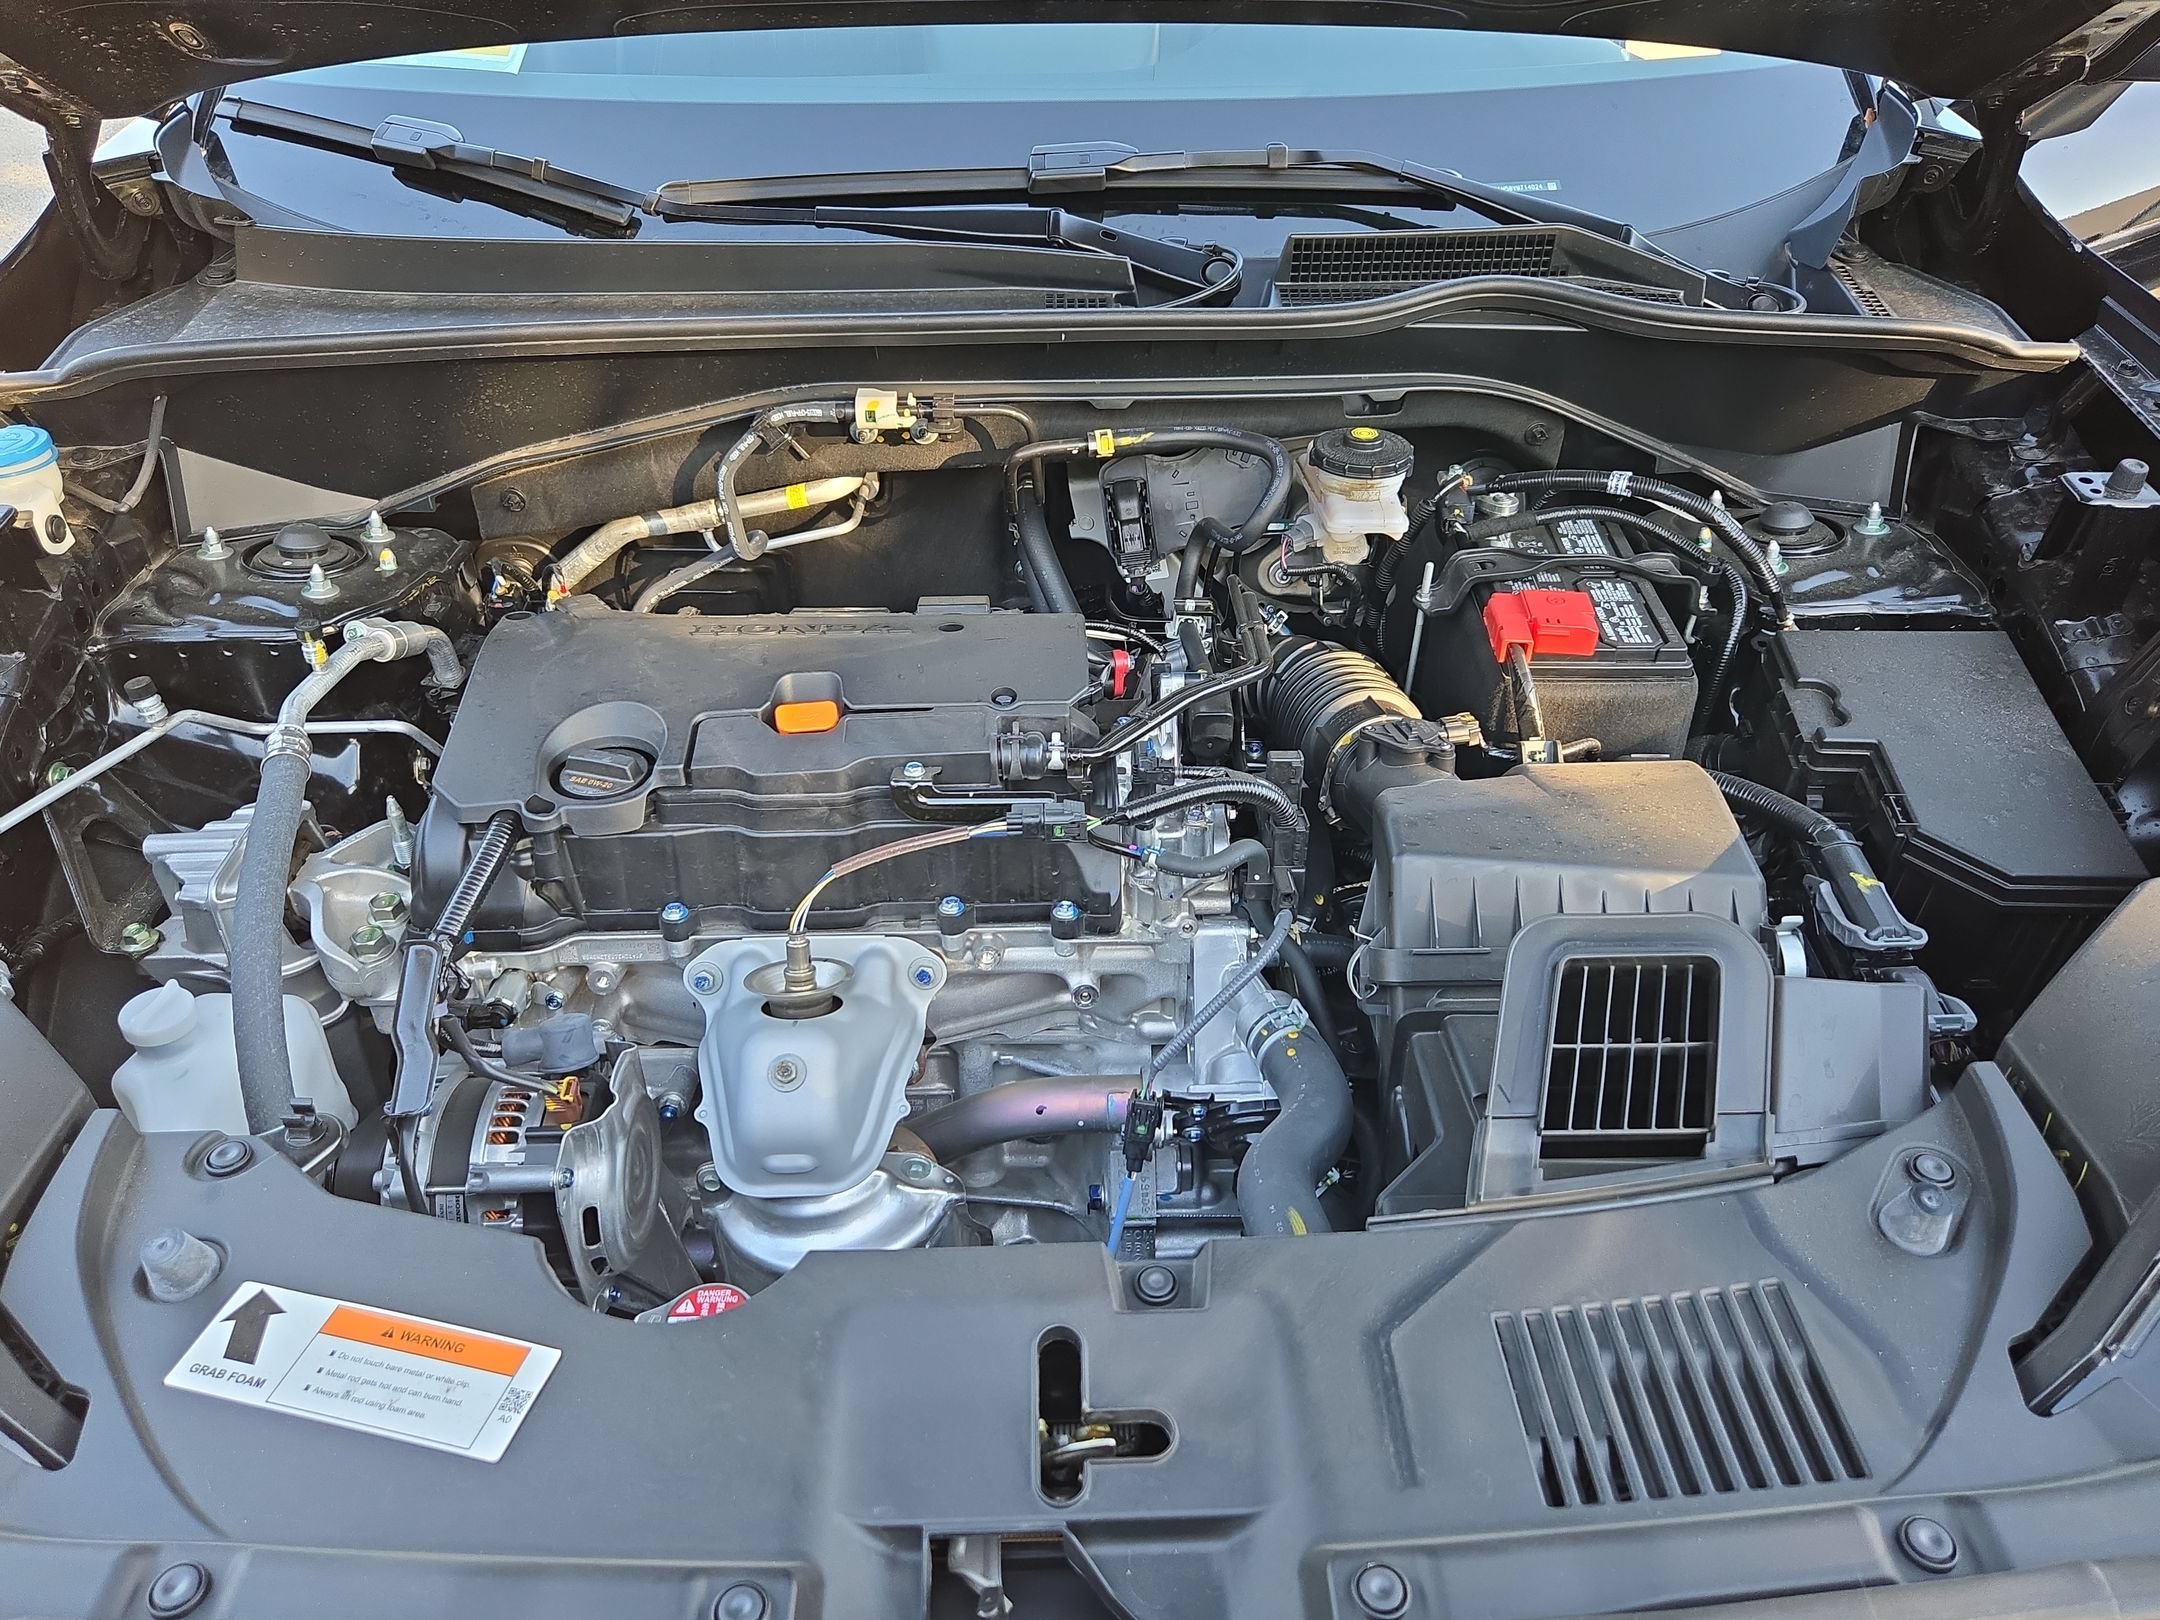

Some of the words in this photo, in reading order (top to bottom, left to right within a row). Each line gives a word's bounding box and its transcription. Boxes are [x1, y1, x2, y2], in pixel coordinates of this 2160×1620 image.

[568, 775, 588, 786] SAE
[588, 779, 614, 789] 0W-20
[697, 1289, 732, 1297] DANGER
[400, 1330, 466, 1353] WARNING
[189, 1362, 227, 1379] GRAB
[227, 1371, 267, 1389] FOAM
[337, 1351, 350, 1360] Do
[350, 1355, 364, 1364] not
[363, 1358, 385, 1368] touch
[384, 1363, 403, 1373] bare
[403, 1367, 426, 1377] metal
[435, 1375, 456, 1385] white
[324, 1367, 347, 1379] Metal
[347, 1373, 362, 1383] rod
[360, 1378, 378, 1387] gets
[378, 1381, 393, 1390] hot
[392, 1385, 409, 1394] and
[407, 1388, 423, 1397] can
[423, 1391, 442, 1401] burn
[312, 1386, 340, 1399] Always
[350, 1395, 365, 1404] rod
[364, 1399, 386, 1410] using
[386, 1402, 407, 1414] foam
